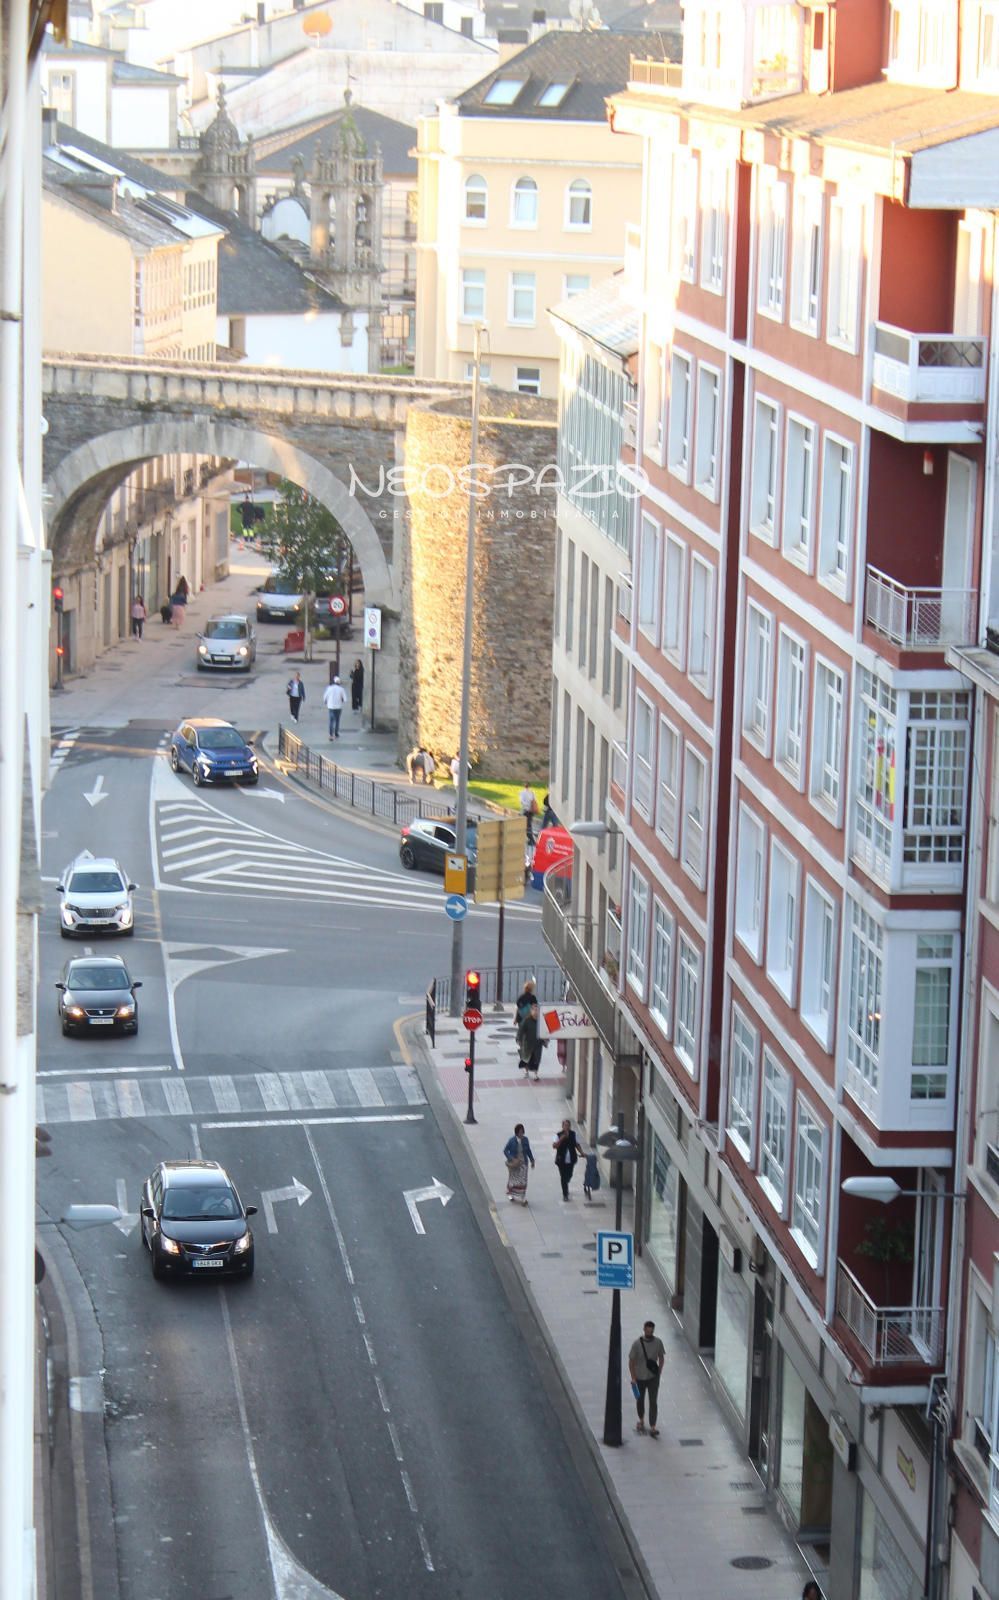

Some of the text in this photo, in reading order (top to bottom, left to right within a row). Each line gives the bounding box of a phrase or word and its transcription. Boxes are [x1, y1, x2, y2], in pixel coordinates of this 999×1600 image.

[463, 1016, 482, 1024] STOP
[559, 1010, 592, 1028] Folde
[608, 1241, 622, 1261] P
